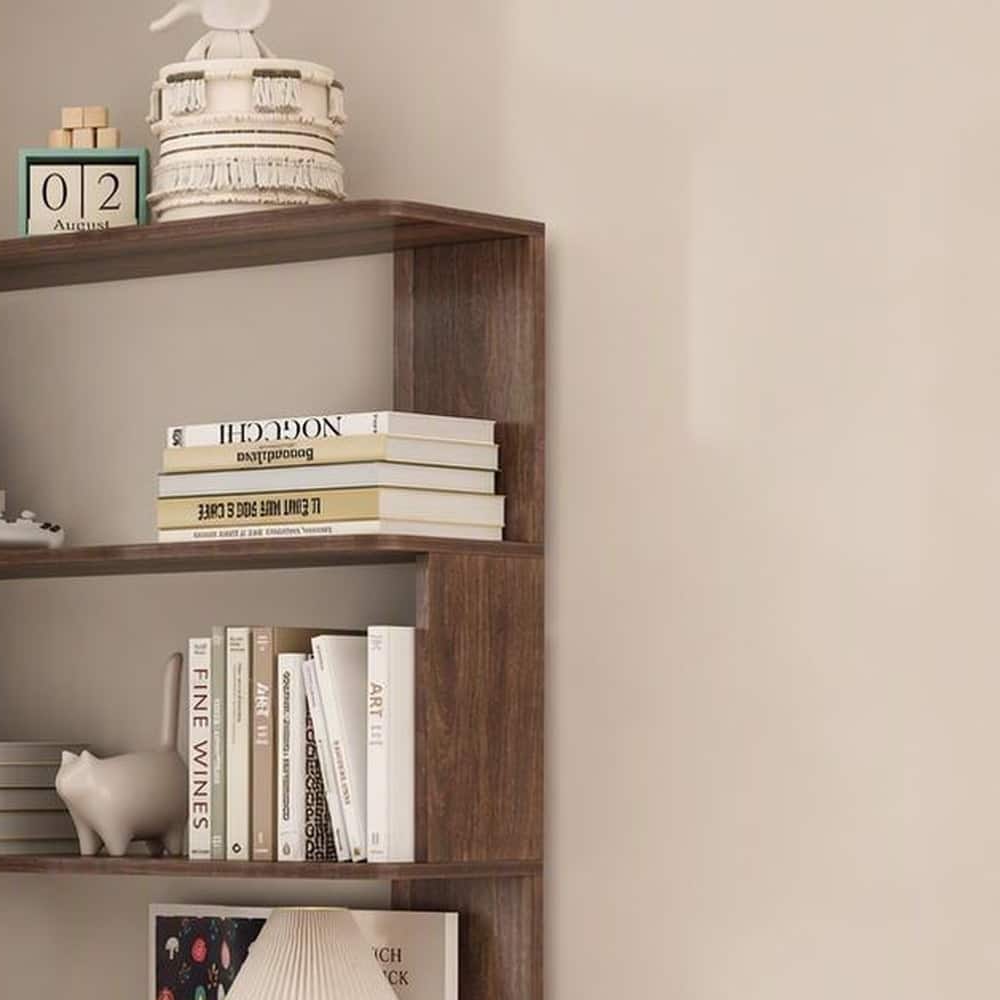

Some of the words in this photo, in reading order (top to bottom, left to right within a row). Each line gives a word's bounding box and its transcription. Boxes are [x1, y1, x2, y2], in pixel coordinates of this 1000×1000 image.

[53, 219, 109, 233] August
[219, 415, 343, 446] NOGUCHI
[192, 667, 209, 728] FINE
[369, 682, 384, 718] ART
[192, 740, 209, 830] WINES
[383, 970, 408, 985] CK
